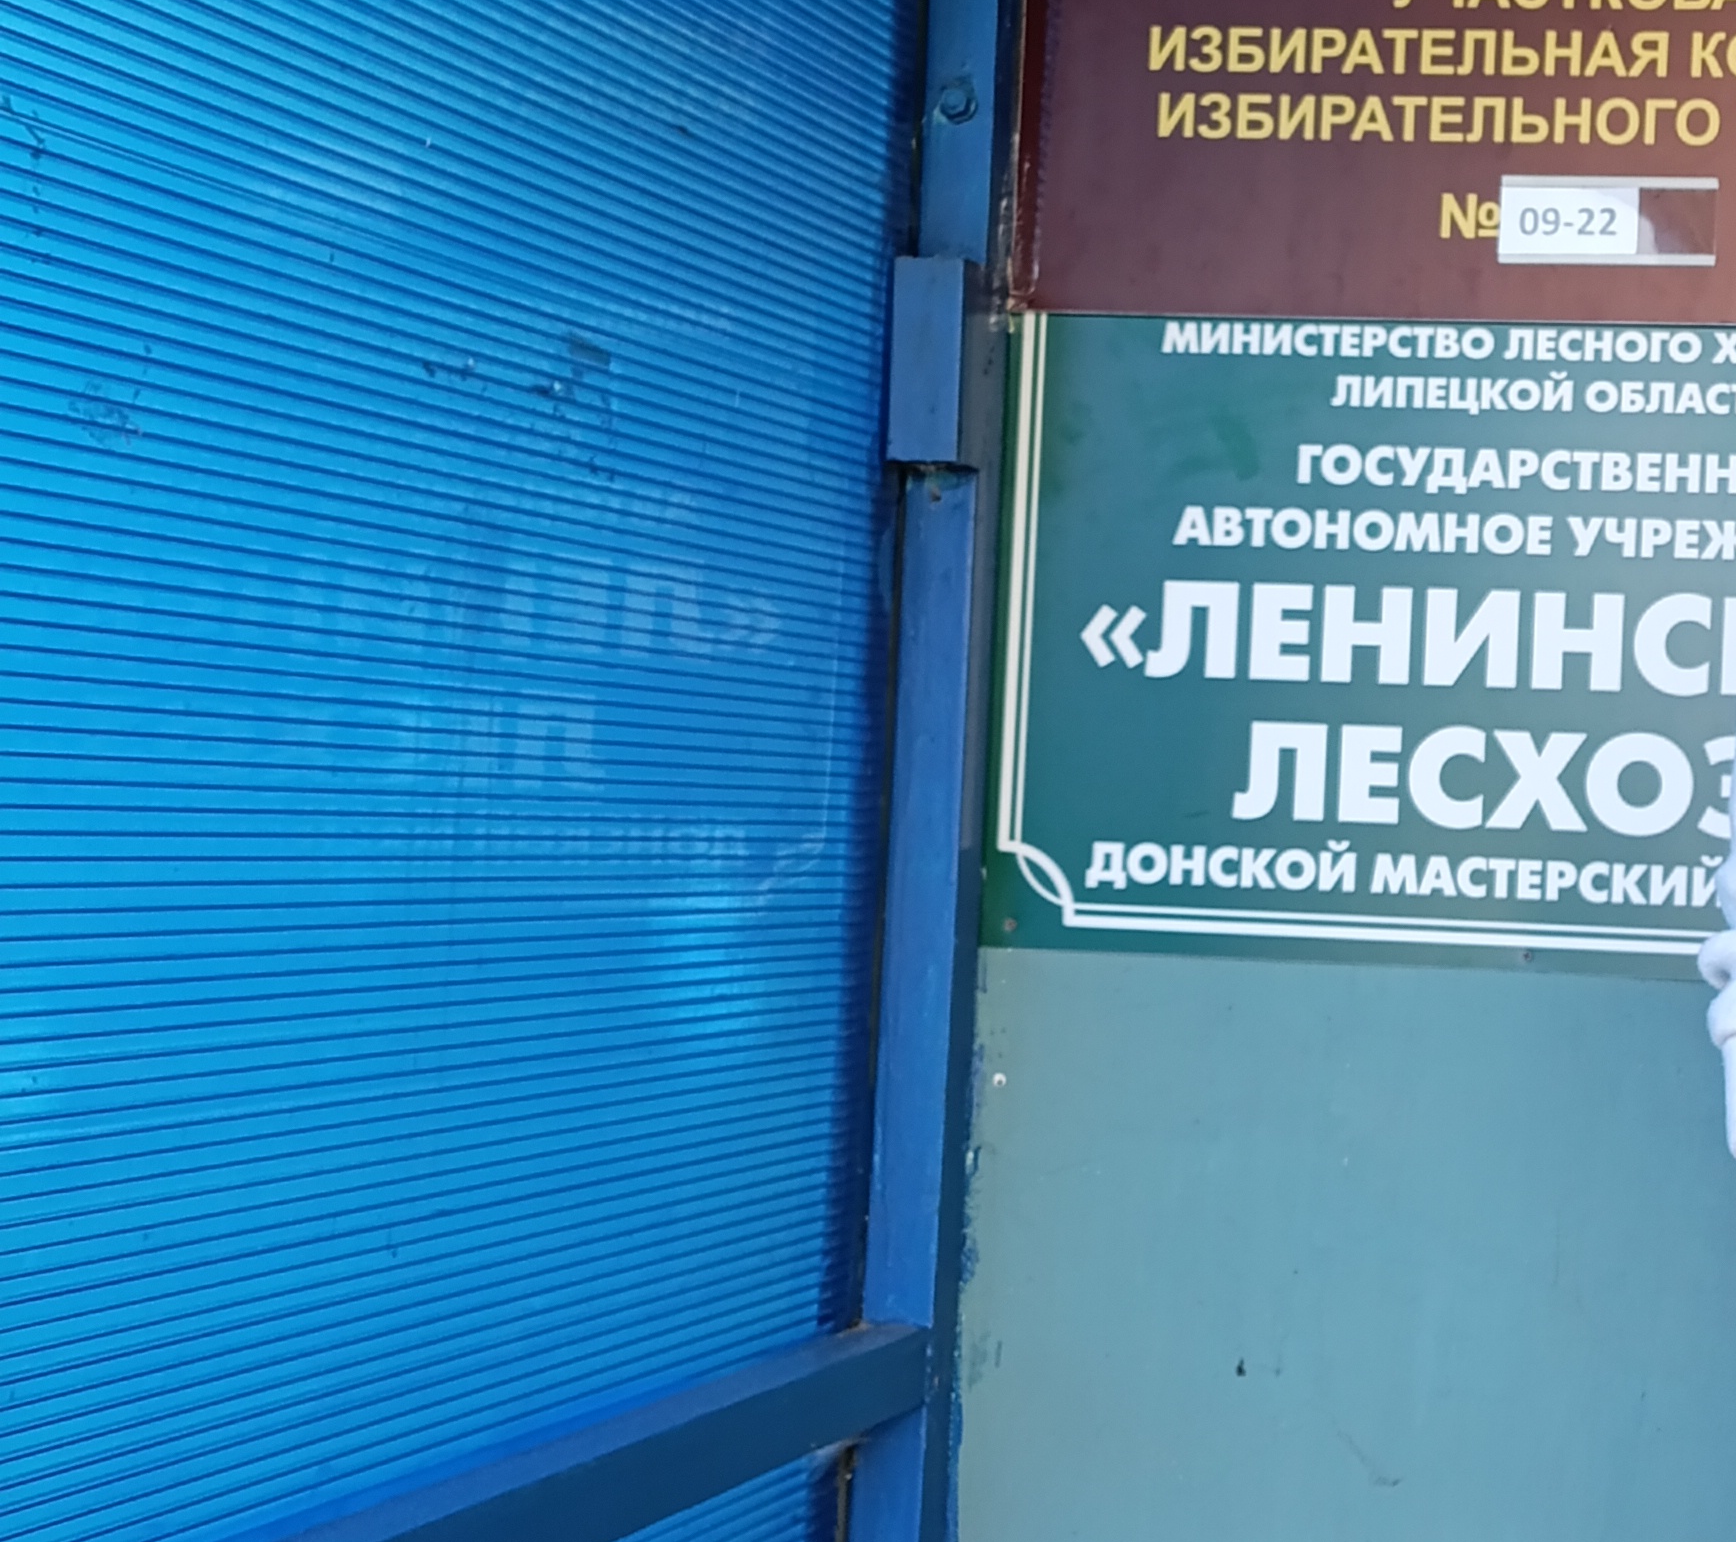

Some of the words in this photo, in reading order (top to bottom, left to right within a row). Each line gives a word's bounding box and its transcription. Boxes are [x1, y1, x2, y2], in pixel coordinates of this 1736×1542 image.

[1148, 26, 1670, 79] ИЗБИРАТЕЛЬНАЯ
[1157, 92, 1721, 147] ИЗБИРАТЕЛЬНОГО
[1439, 192, 1500, 240] №
[1518, 206, 1618, 237] 09-22
[1162, 321, 1495, 361] МИНИСТЕРСТВО
[1503, 328, 1703, 364] ЛЕСНОГО
[1331, 370, 1574, 415] ЛИПЕЦКОЙ
[1173, 506, 1554, 557] АВТОНОМНОЕ
[1085, 839, 1358, 893] ДОНСКОЙ
[1370, 852, 1722, 907] МАСТЕРСКИЙ
